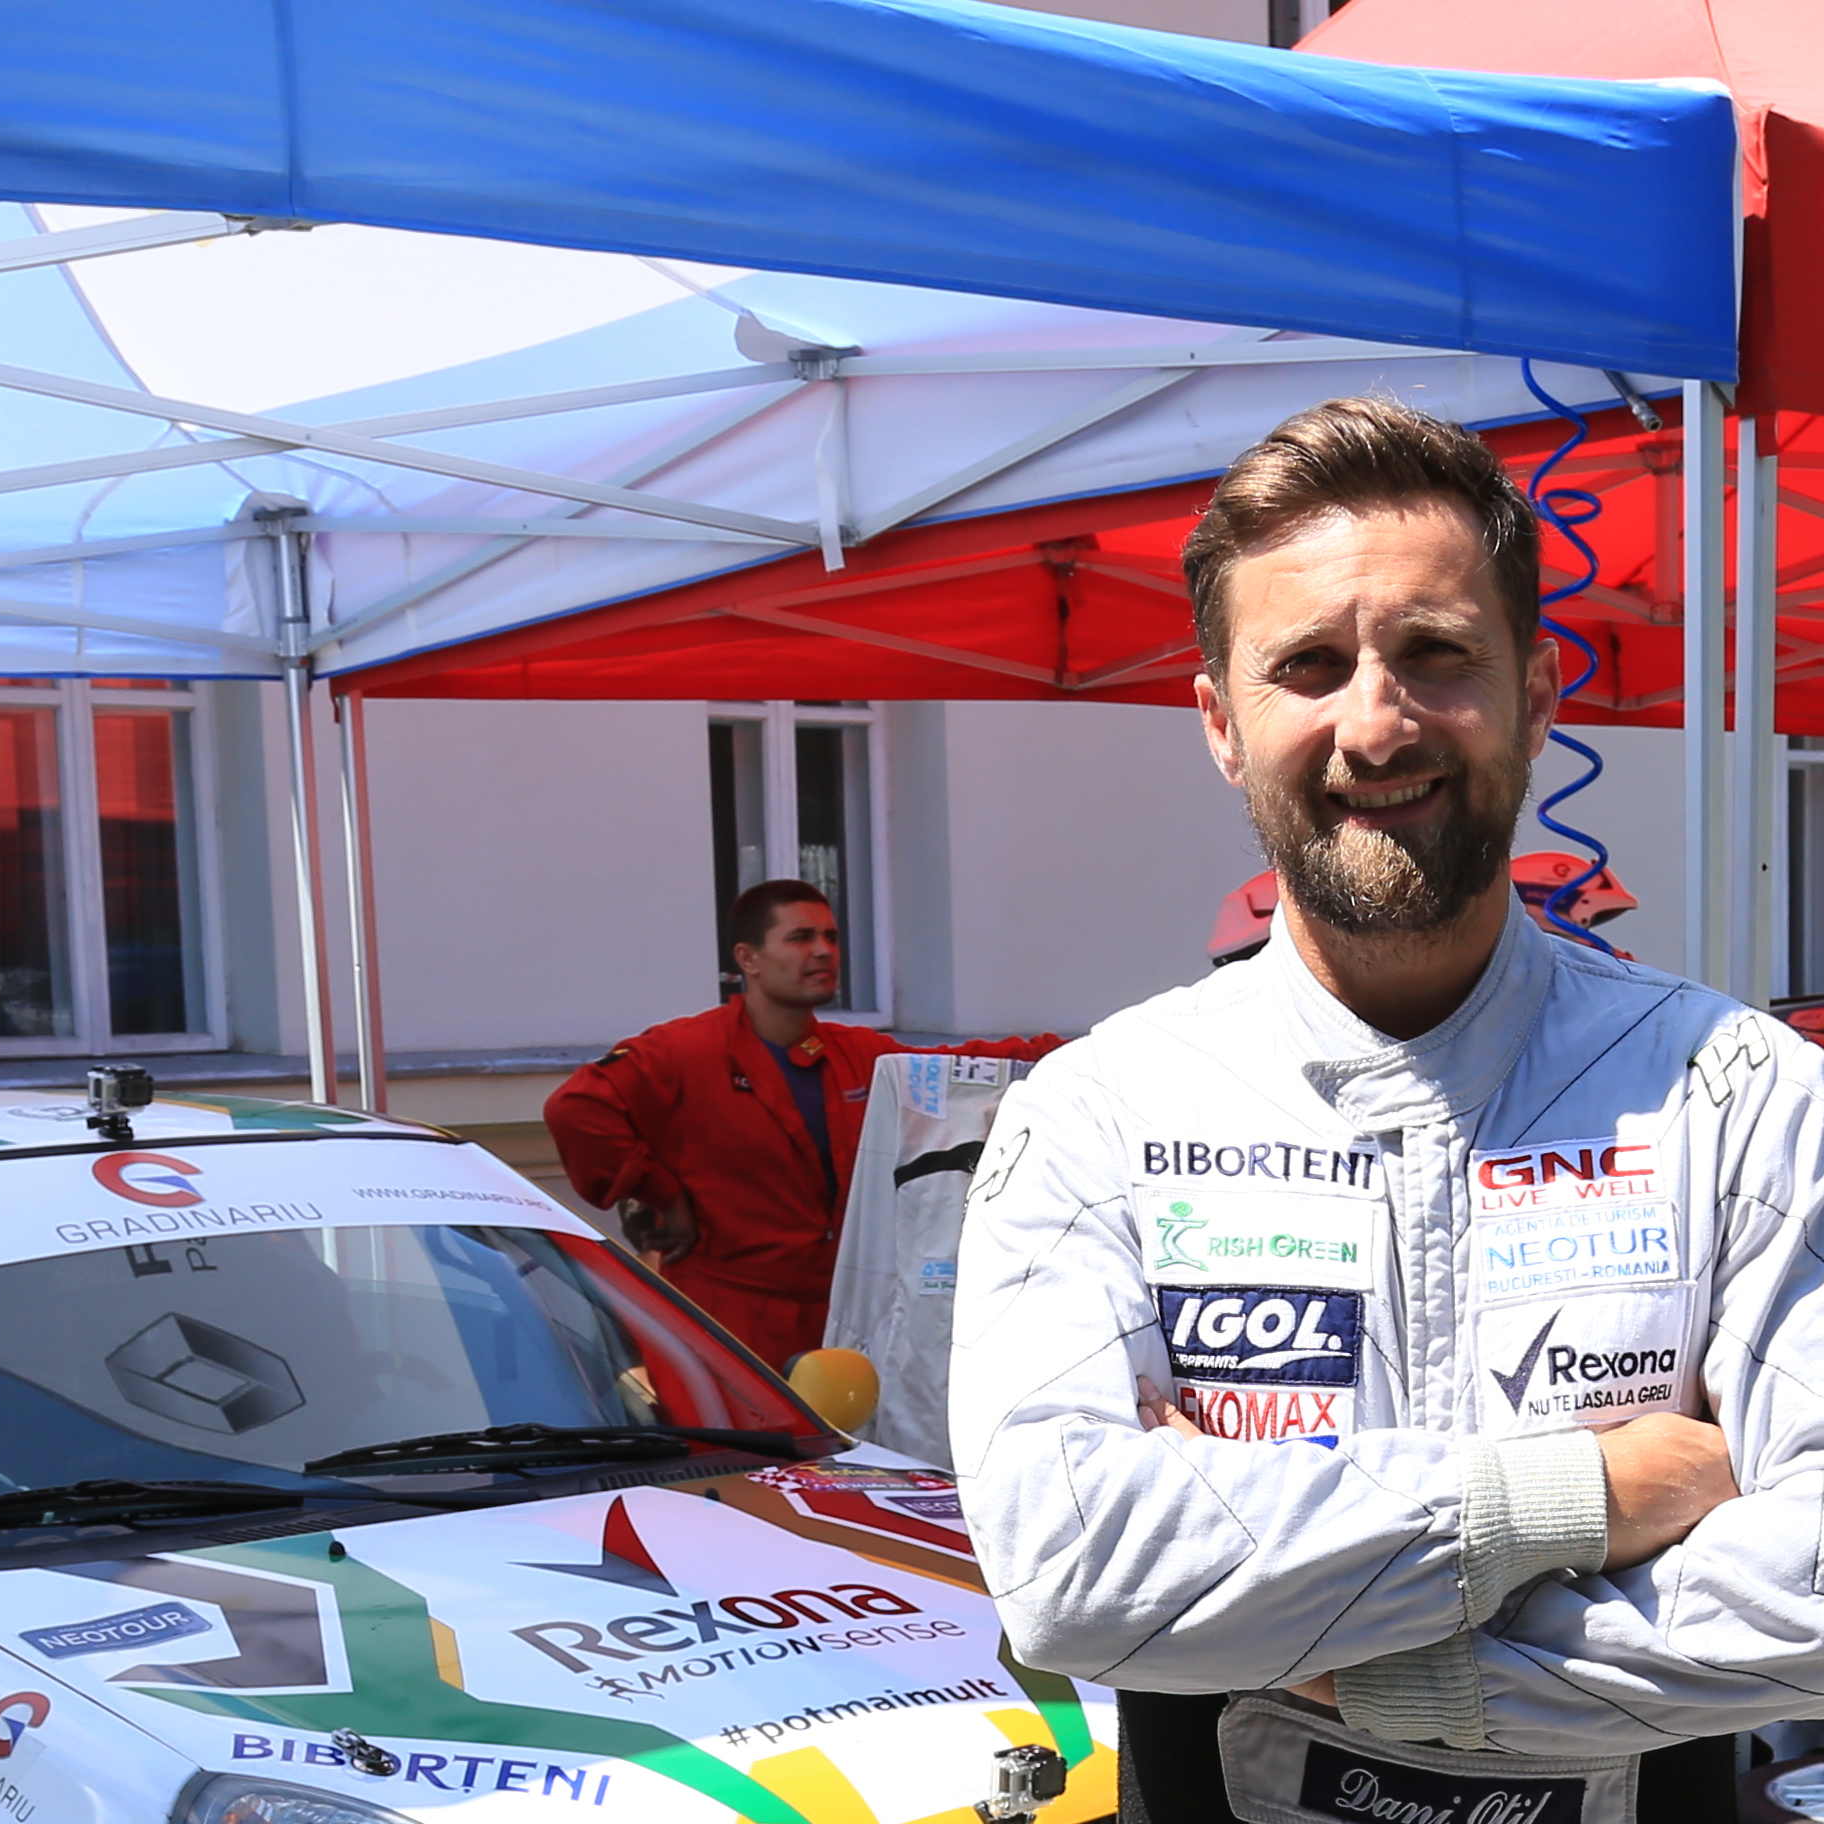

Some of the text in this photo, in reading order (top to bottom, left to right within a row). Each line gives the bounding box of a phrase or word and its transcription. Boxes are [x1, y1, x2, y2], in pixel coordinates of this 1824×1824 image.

[1477, 1144, 1655, 1190] GNC
[1481, 1179, 1658, 1211] LIVE WELL
[54, 1202, 323, 1245] GRADINARIU
[1269, 1232, 1359, 1264] GREEN
[1485, 1226, 1669, 1272] NEOTUR
[1528, 1396, 1550, 1417] NU
[1554, 1394, 1571, 1412] TE
[1638, 1384, 1674, 1404] GREU
[37, 1610, 191, 1650] NEOTOUR
[510, 1583, 925, 1674] Rexona
[718, 1676, 1009, 1748] #potmaimult
